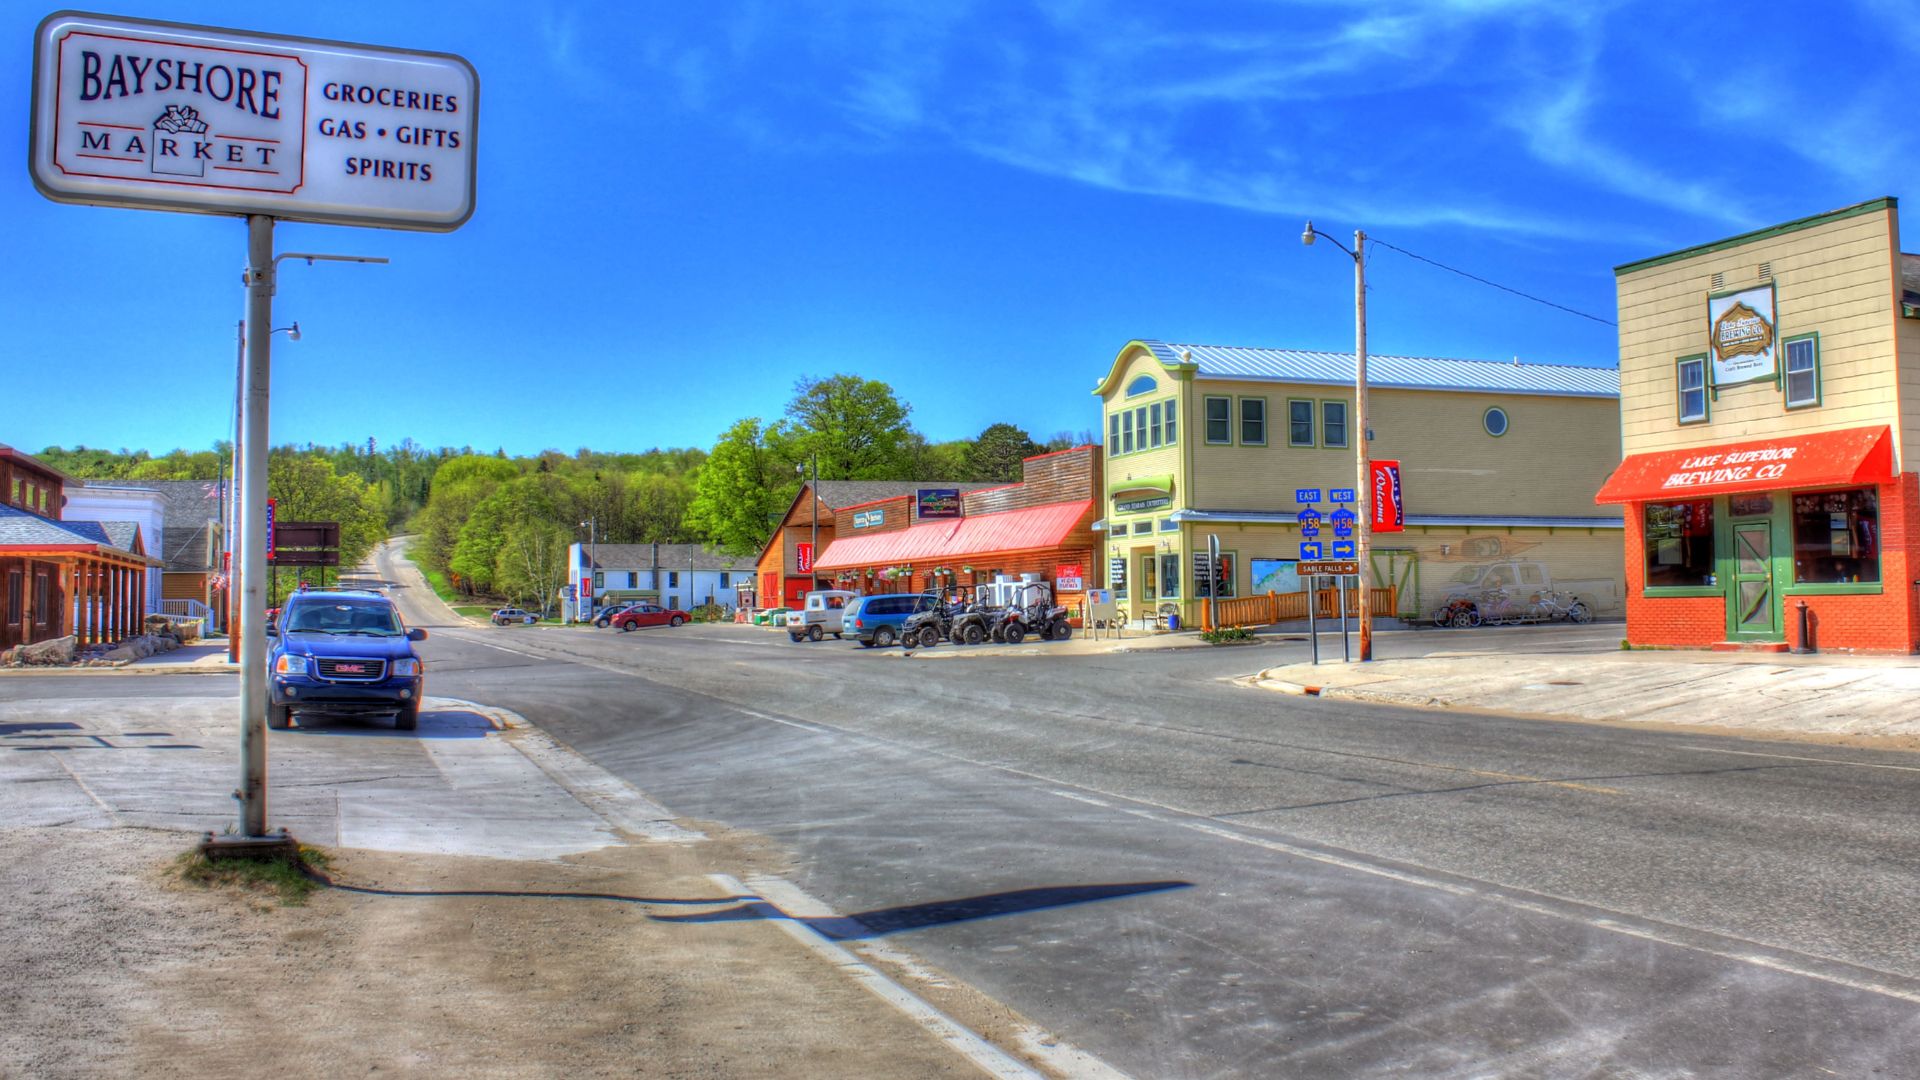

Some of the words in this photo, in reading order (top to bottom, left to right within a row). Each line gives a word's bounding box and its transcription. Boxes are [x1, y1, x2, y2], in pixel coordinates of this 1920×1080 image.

[80, 51, 282, 119] BAYSHORE
[323, 82, 457, 113] GROCERIES
[319, 118, 366, 139] GAS
[396, 125, 461, 149] GIFTS
[81, 130, 276, 165] MARKET
[346, 157, 432, 181] SPIRITS
[1720, 326, 1751, 342] BREWING
[1680, 454, 1722, 469] LAKE
[1723, 447, 1797, 465] SUPERIOR
[1664, 465, 1753, 487] BREWING
[1299, 491, 1317, 501] EAST
[1332, 491, 1351, 501] WEST
[1375, 469, 1386, 524] Welcome
[335, 664, 365, 672] GMC
